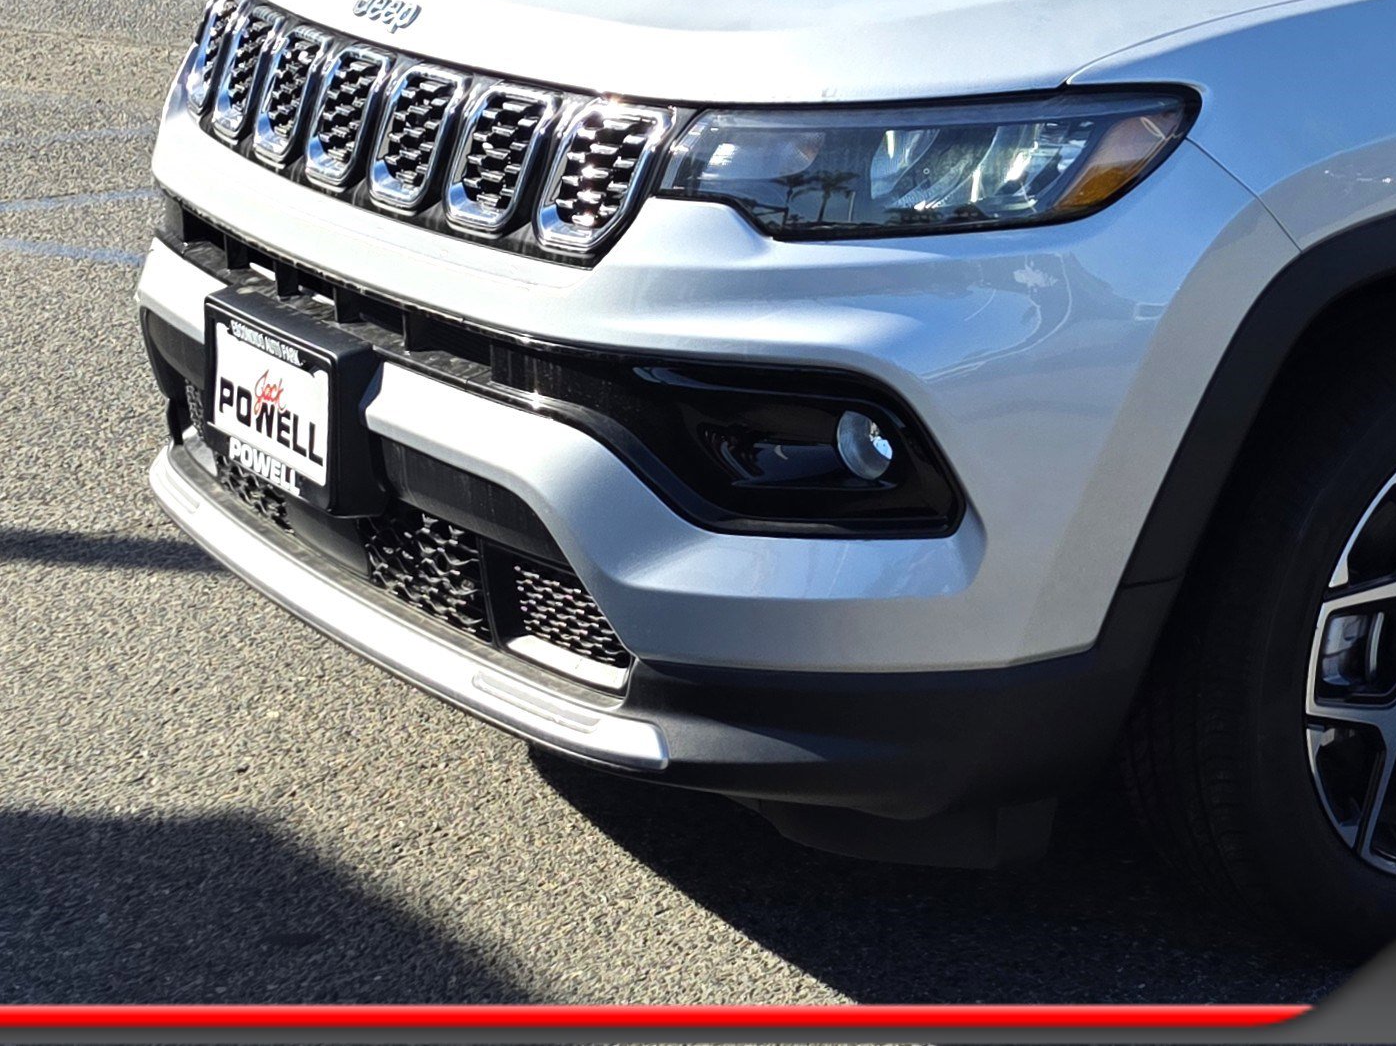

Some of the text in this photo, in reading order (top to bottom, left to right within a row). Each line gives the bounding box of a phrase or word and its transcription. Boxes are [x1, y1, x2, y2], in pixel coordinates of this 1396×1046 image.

[218, 376, 324, 467] POWELL
[254, 369, 287, 416] Jack
[229, 437, 301, 497] POWELL
